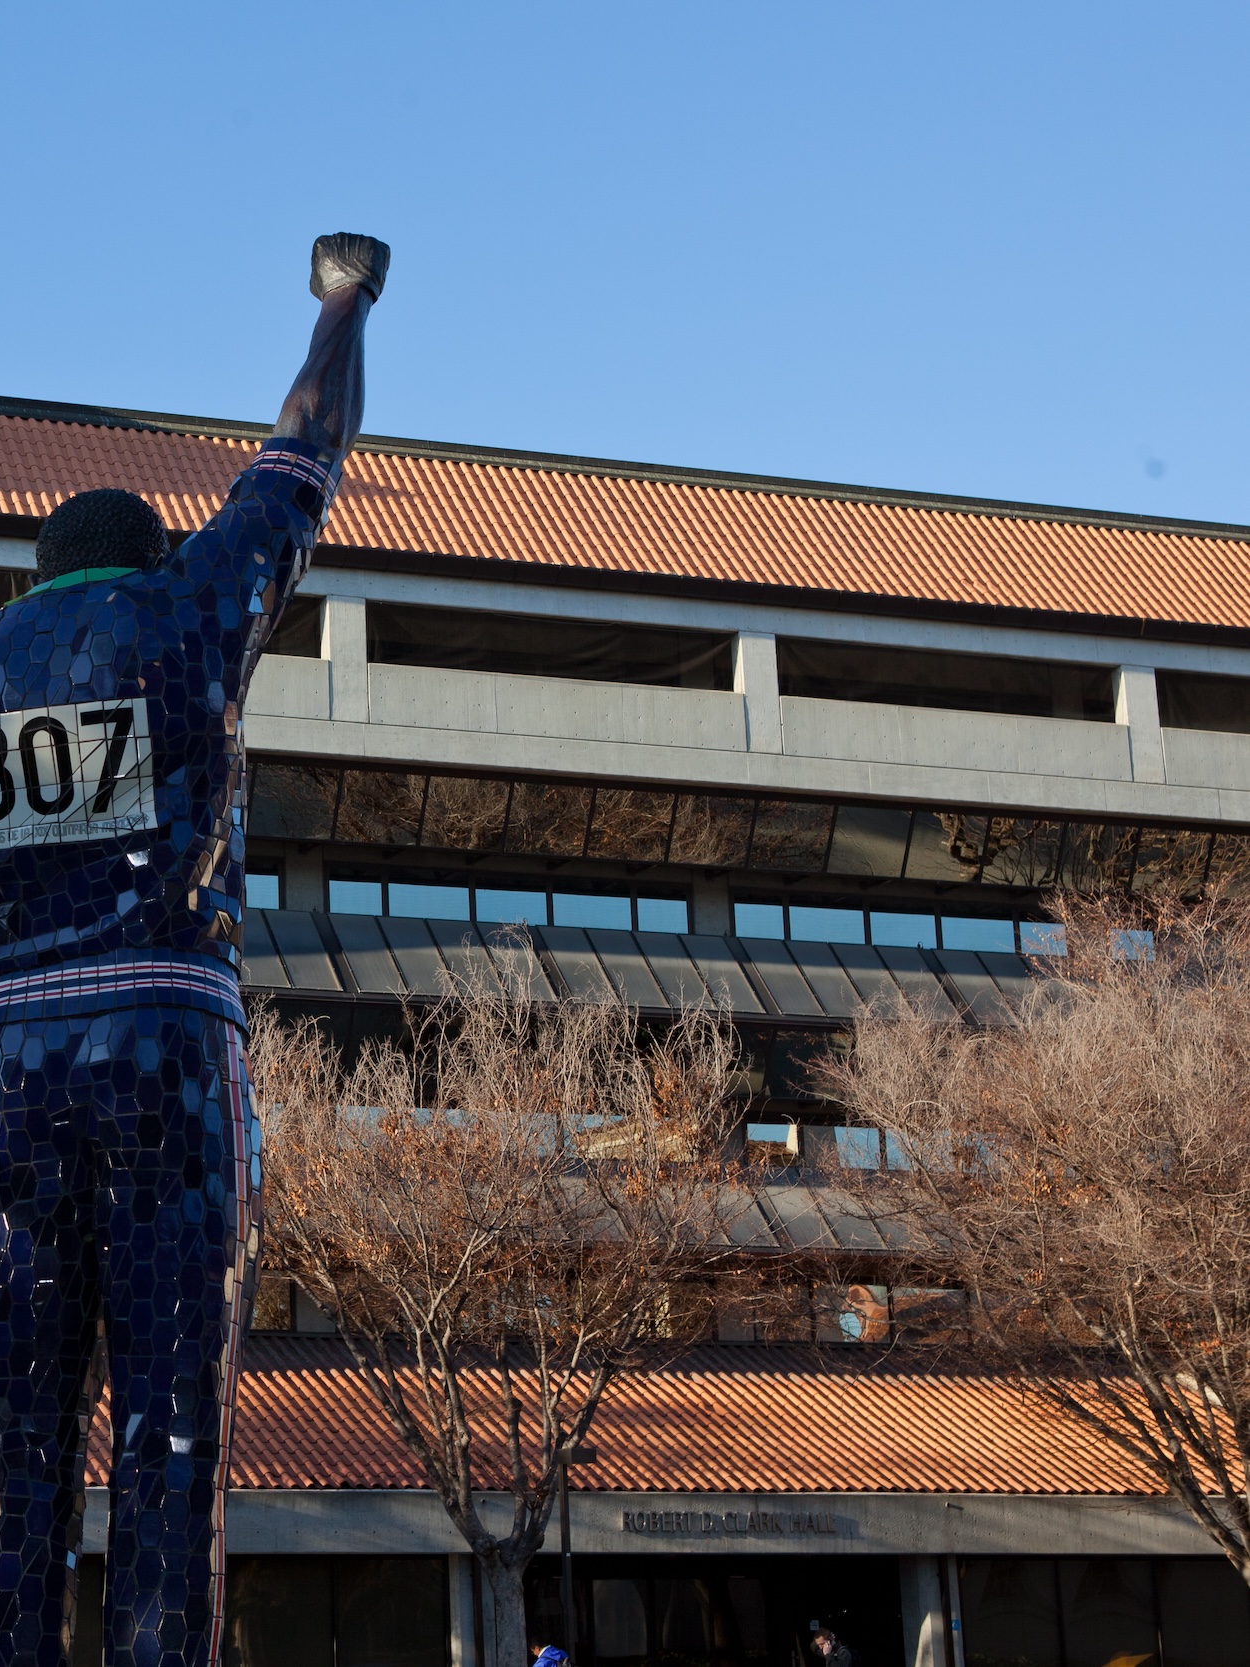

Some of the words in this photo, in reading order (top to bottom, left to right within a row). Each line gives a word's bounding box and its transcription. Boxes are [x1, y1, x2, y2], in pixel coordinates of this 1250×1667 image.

[621, 1510, 694, 1534] ROBERT
[700, 1511, 718, 1534] D.
[722, 1510, 783, 1535] CLARK
[789, 1511, 837, 1535] HALL
